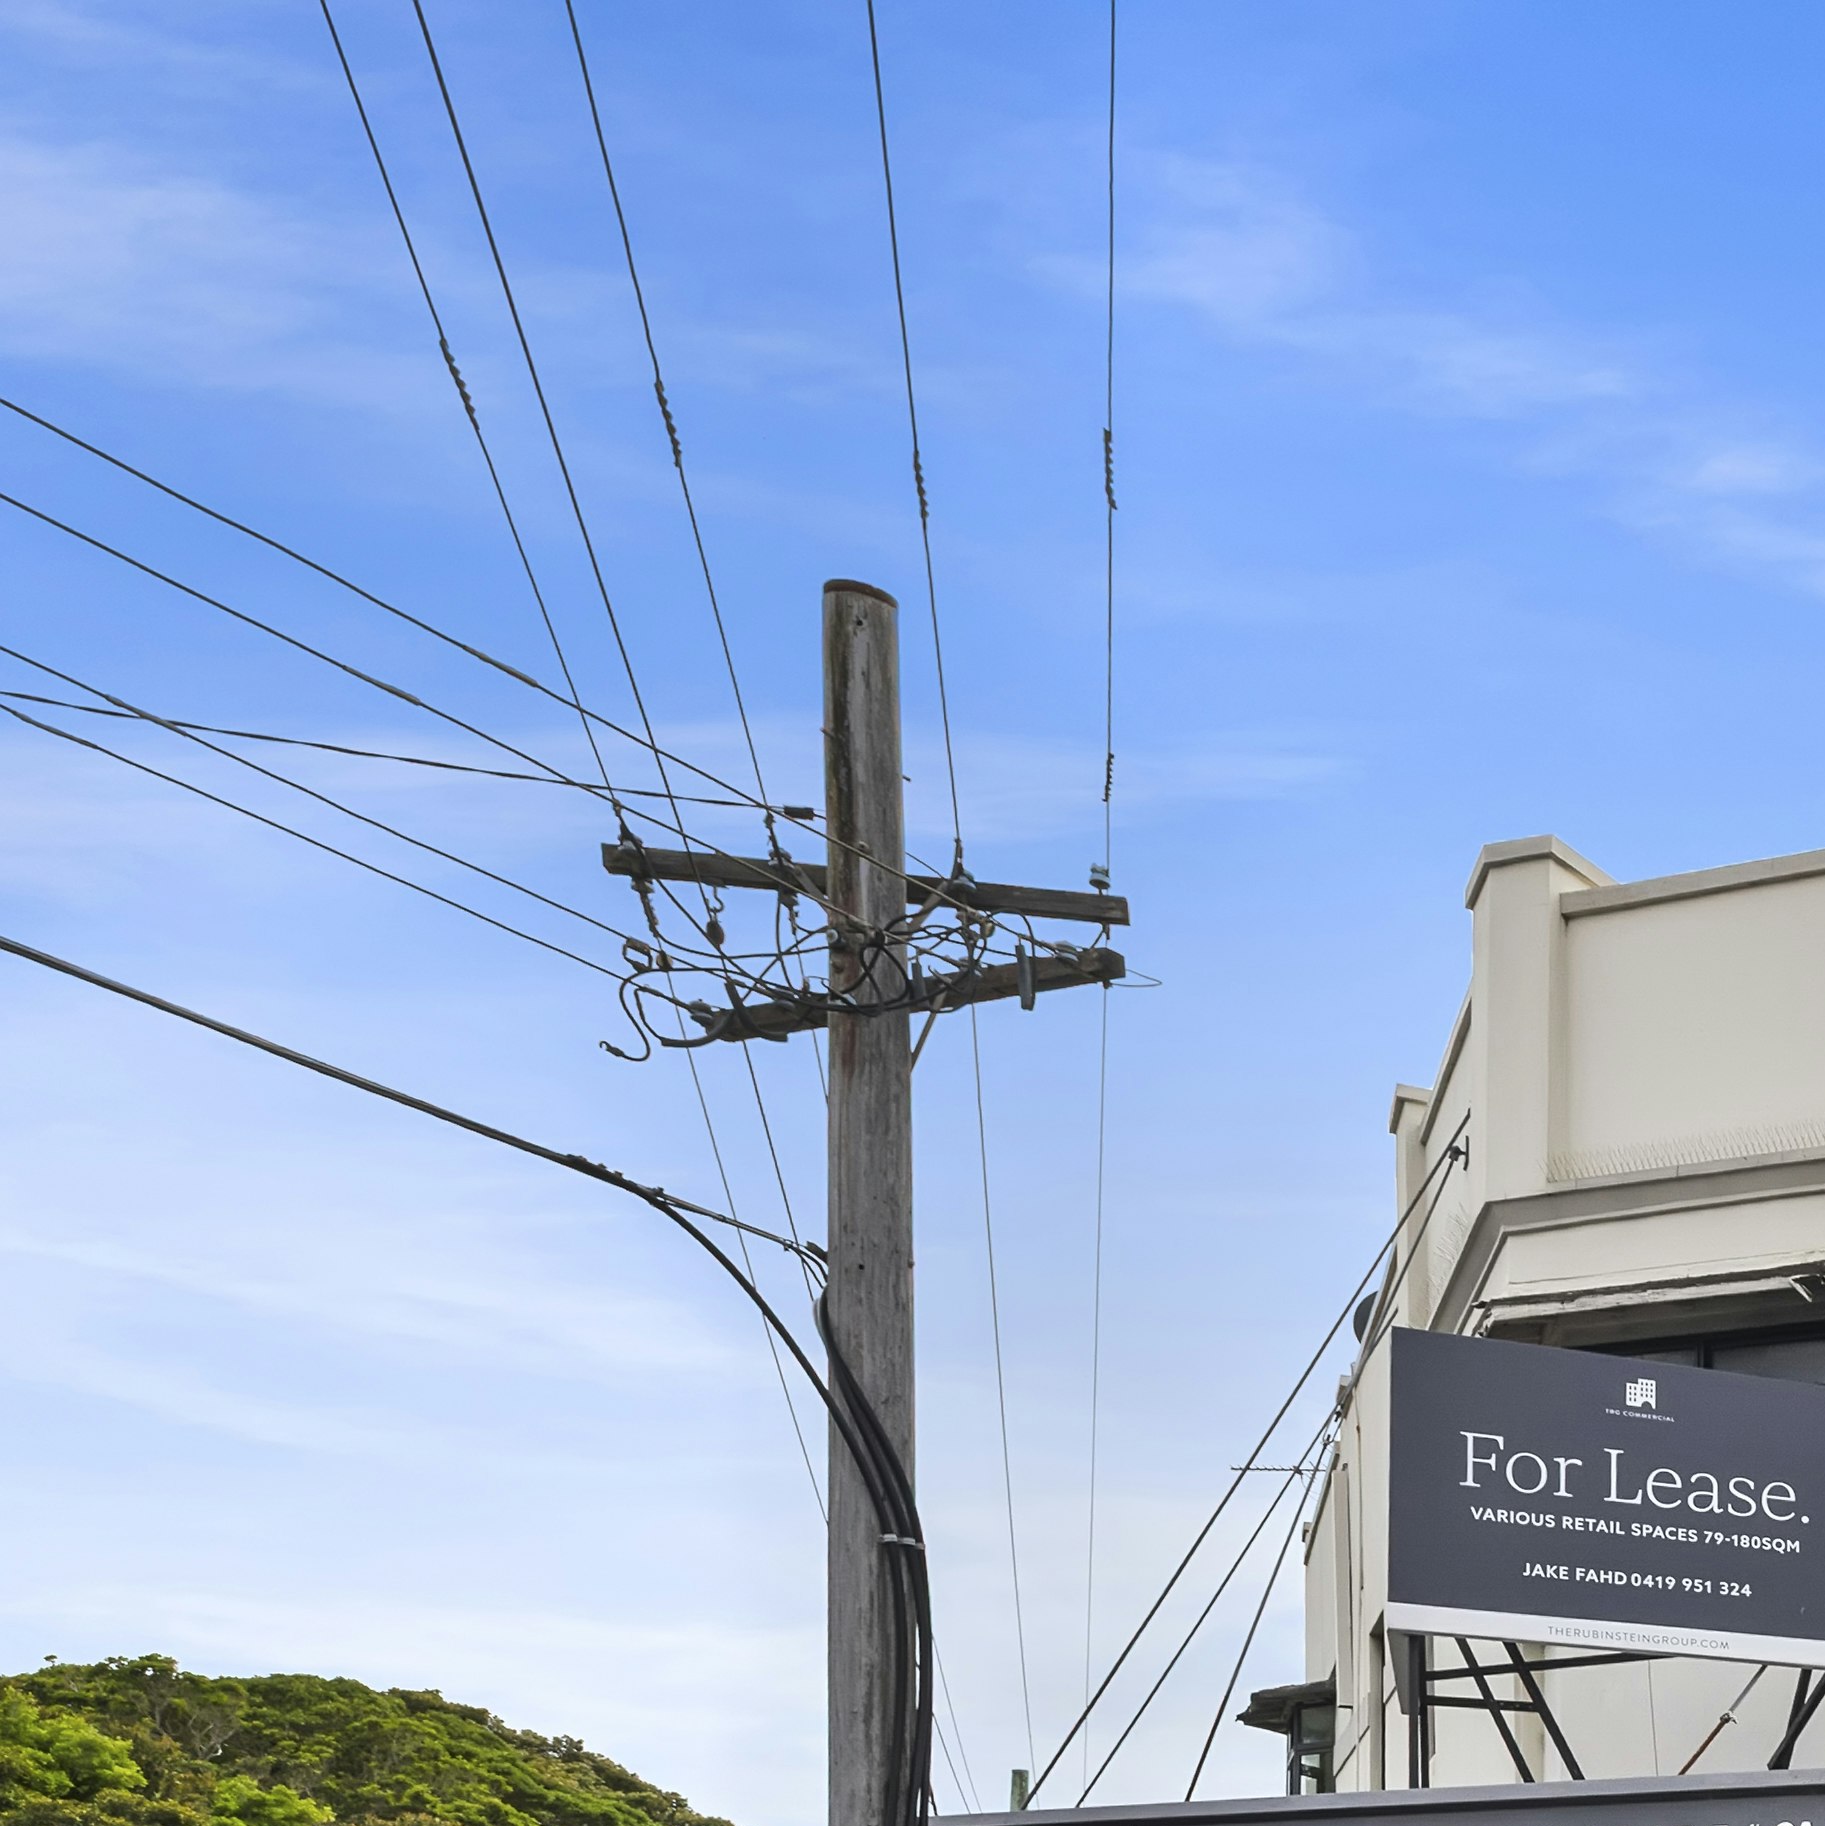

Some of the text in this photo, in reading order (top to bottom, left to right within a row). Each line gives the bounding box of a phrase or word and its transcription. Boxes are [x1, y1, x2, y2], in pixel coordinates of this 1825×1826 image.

[1623, 1410, 1675, 1423] COMMERCIAL
[1458, 1430, 1811, 1525] For Lease.
[1470, 1505, 1801, 1554] VARIOUS RETAIL SPACES 79-180SQM
[1522, 1562, 1753, 1598] JAKE FAHD 0419 951 324
[1547, 1625, 1731, 1650] THERUBINSTEINGROUP.COM
